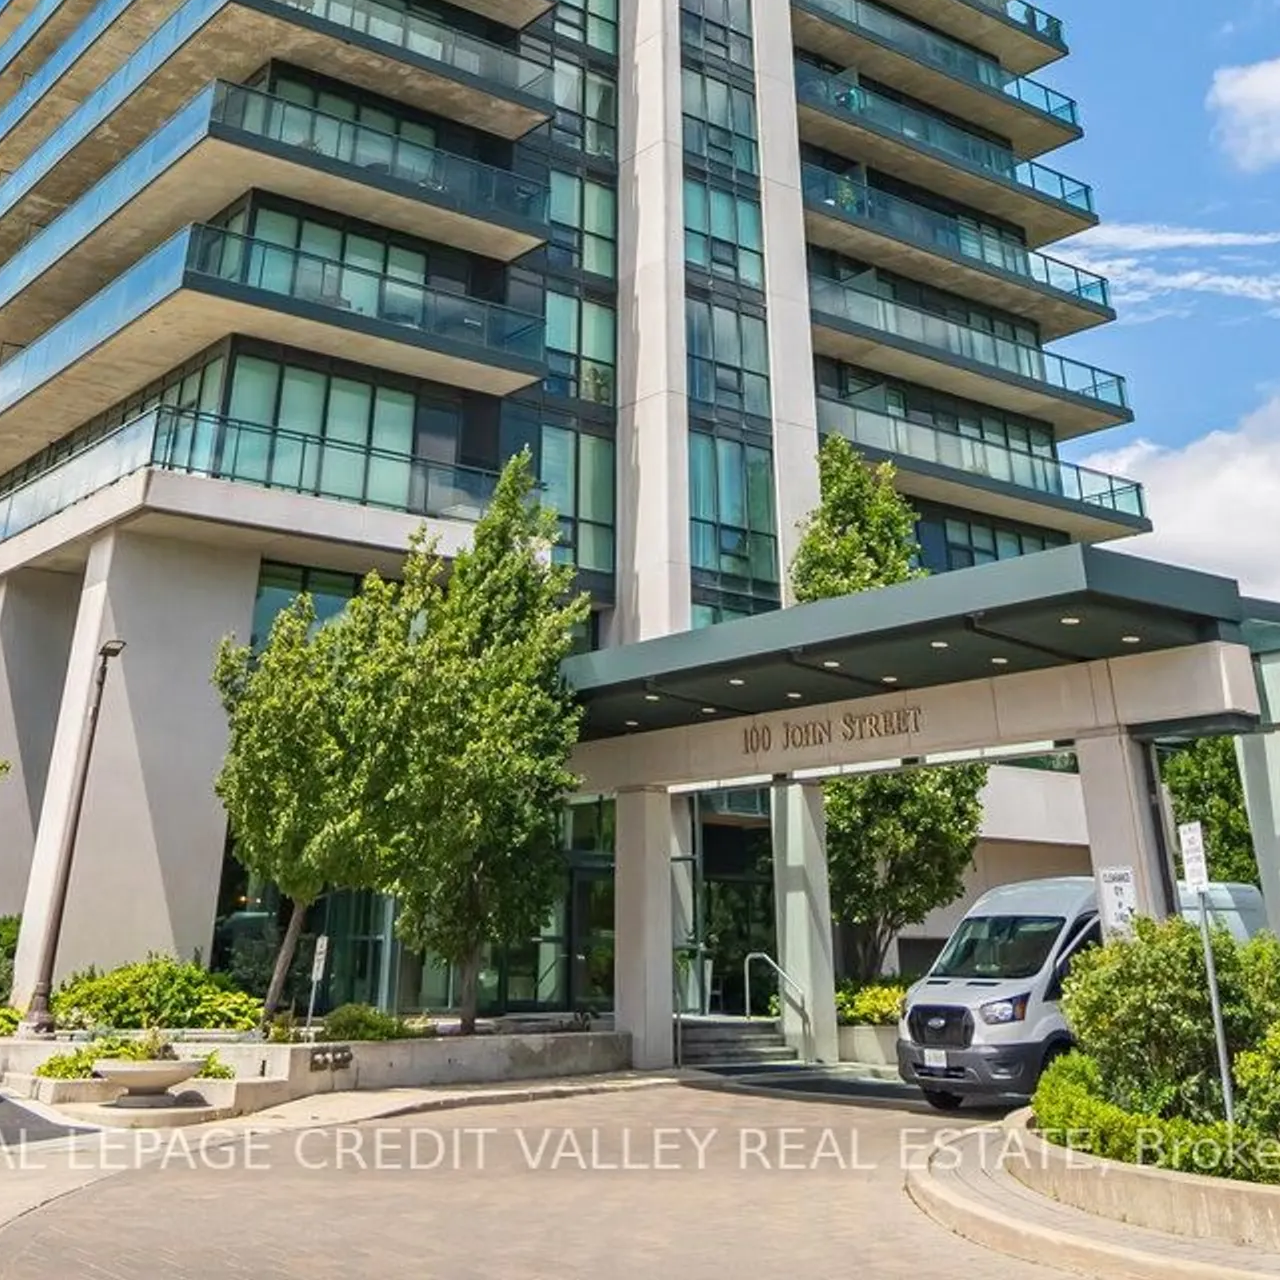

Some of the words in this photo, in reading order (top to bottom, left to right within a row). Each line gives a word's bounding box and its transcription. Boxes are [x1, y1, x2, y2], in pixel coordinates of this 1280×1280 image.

[742, 726, 771, 755] 100
[782, 720, 832, 751] JOHN
[842, 707, 922, 741] STREET
